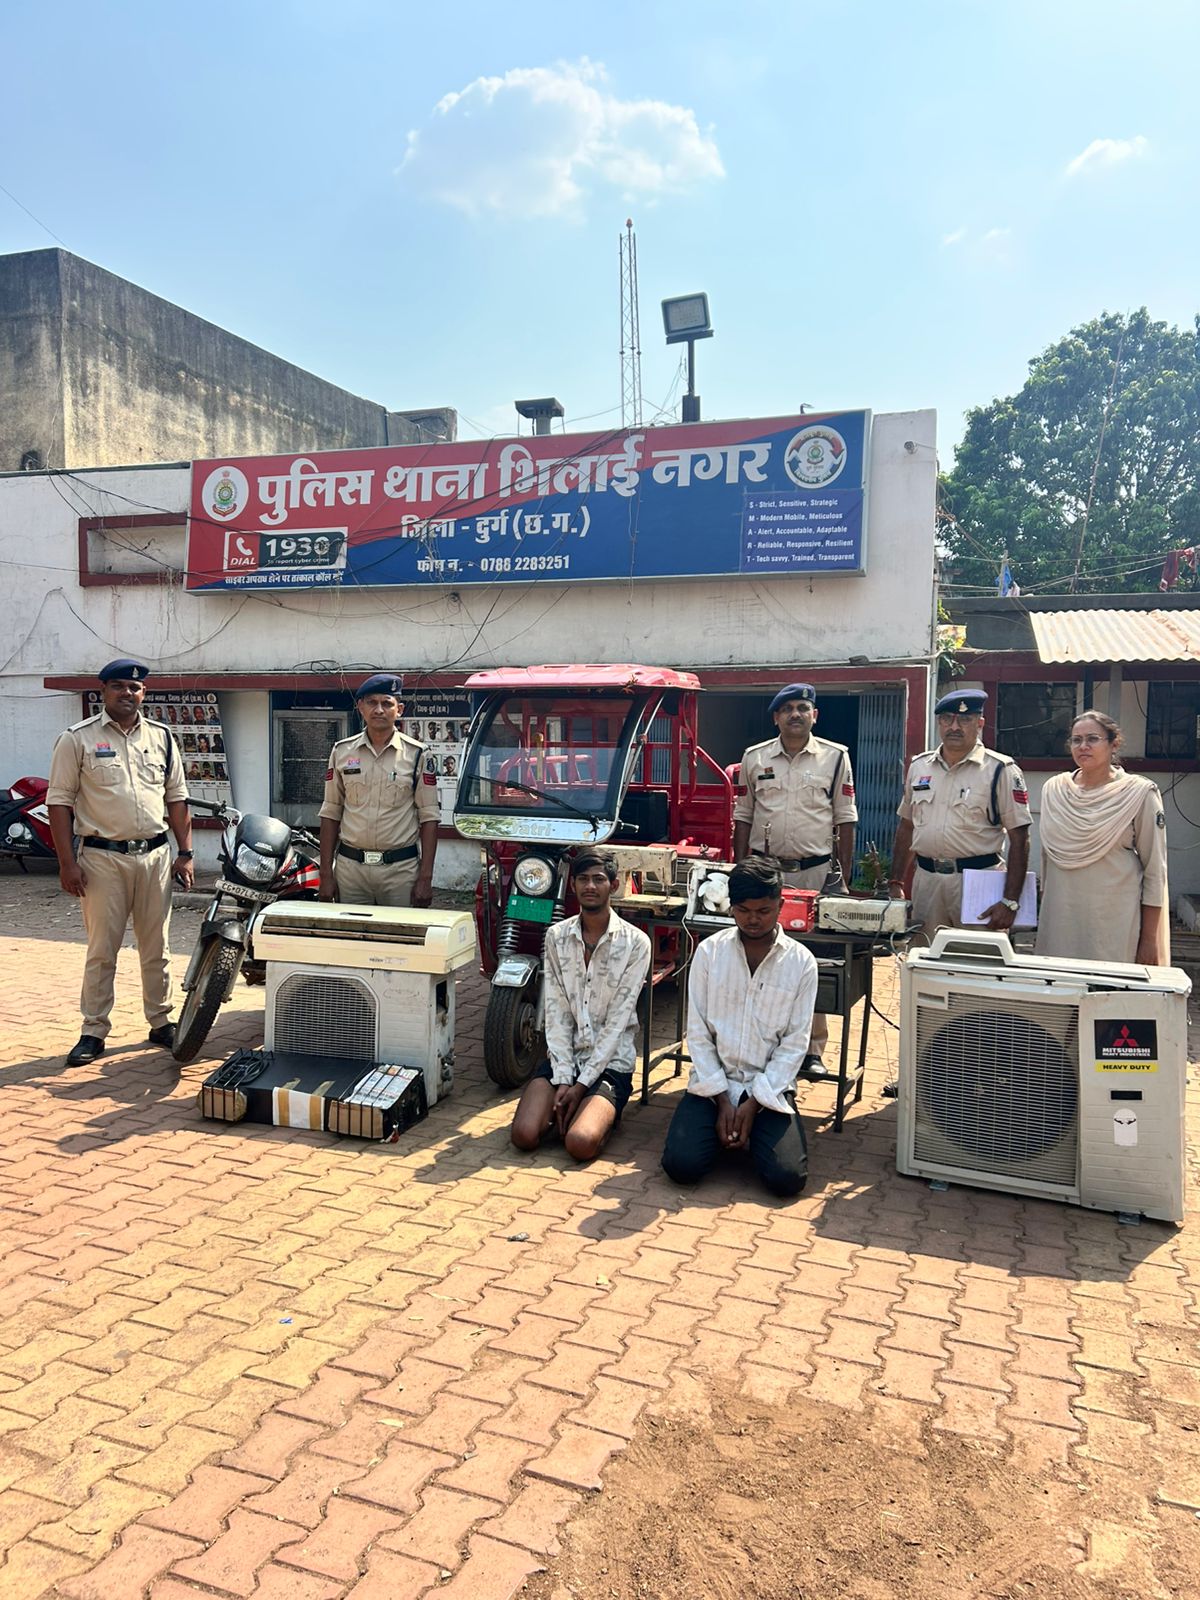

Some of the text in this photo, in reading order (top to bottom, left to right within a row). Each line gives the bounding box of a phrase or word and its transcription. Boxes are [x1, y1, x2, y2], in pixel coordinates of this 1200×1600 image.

[257, 435, 771, 525] पुलिस थाना भिलाई नगर
[810, 498, 838, 507] Strategic
[760, 514, 783, 522] Modern
[401, 514, 458, 538] जिला
[475, 509, 509, 544] दुर्ग
[816, 525, 847, 534] Adaptable
[266, 536, 330, 557] 1930
[825, 539, 853, 547] Resilient
[230, 557, 257, 565] DIAL
[818, 553, 855, 561] Transparent
[515, 555, 569, 571] 2283251
